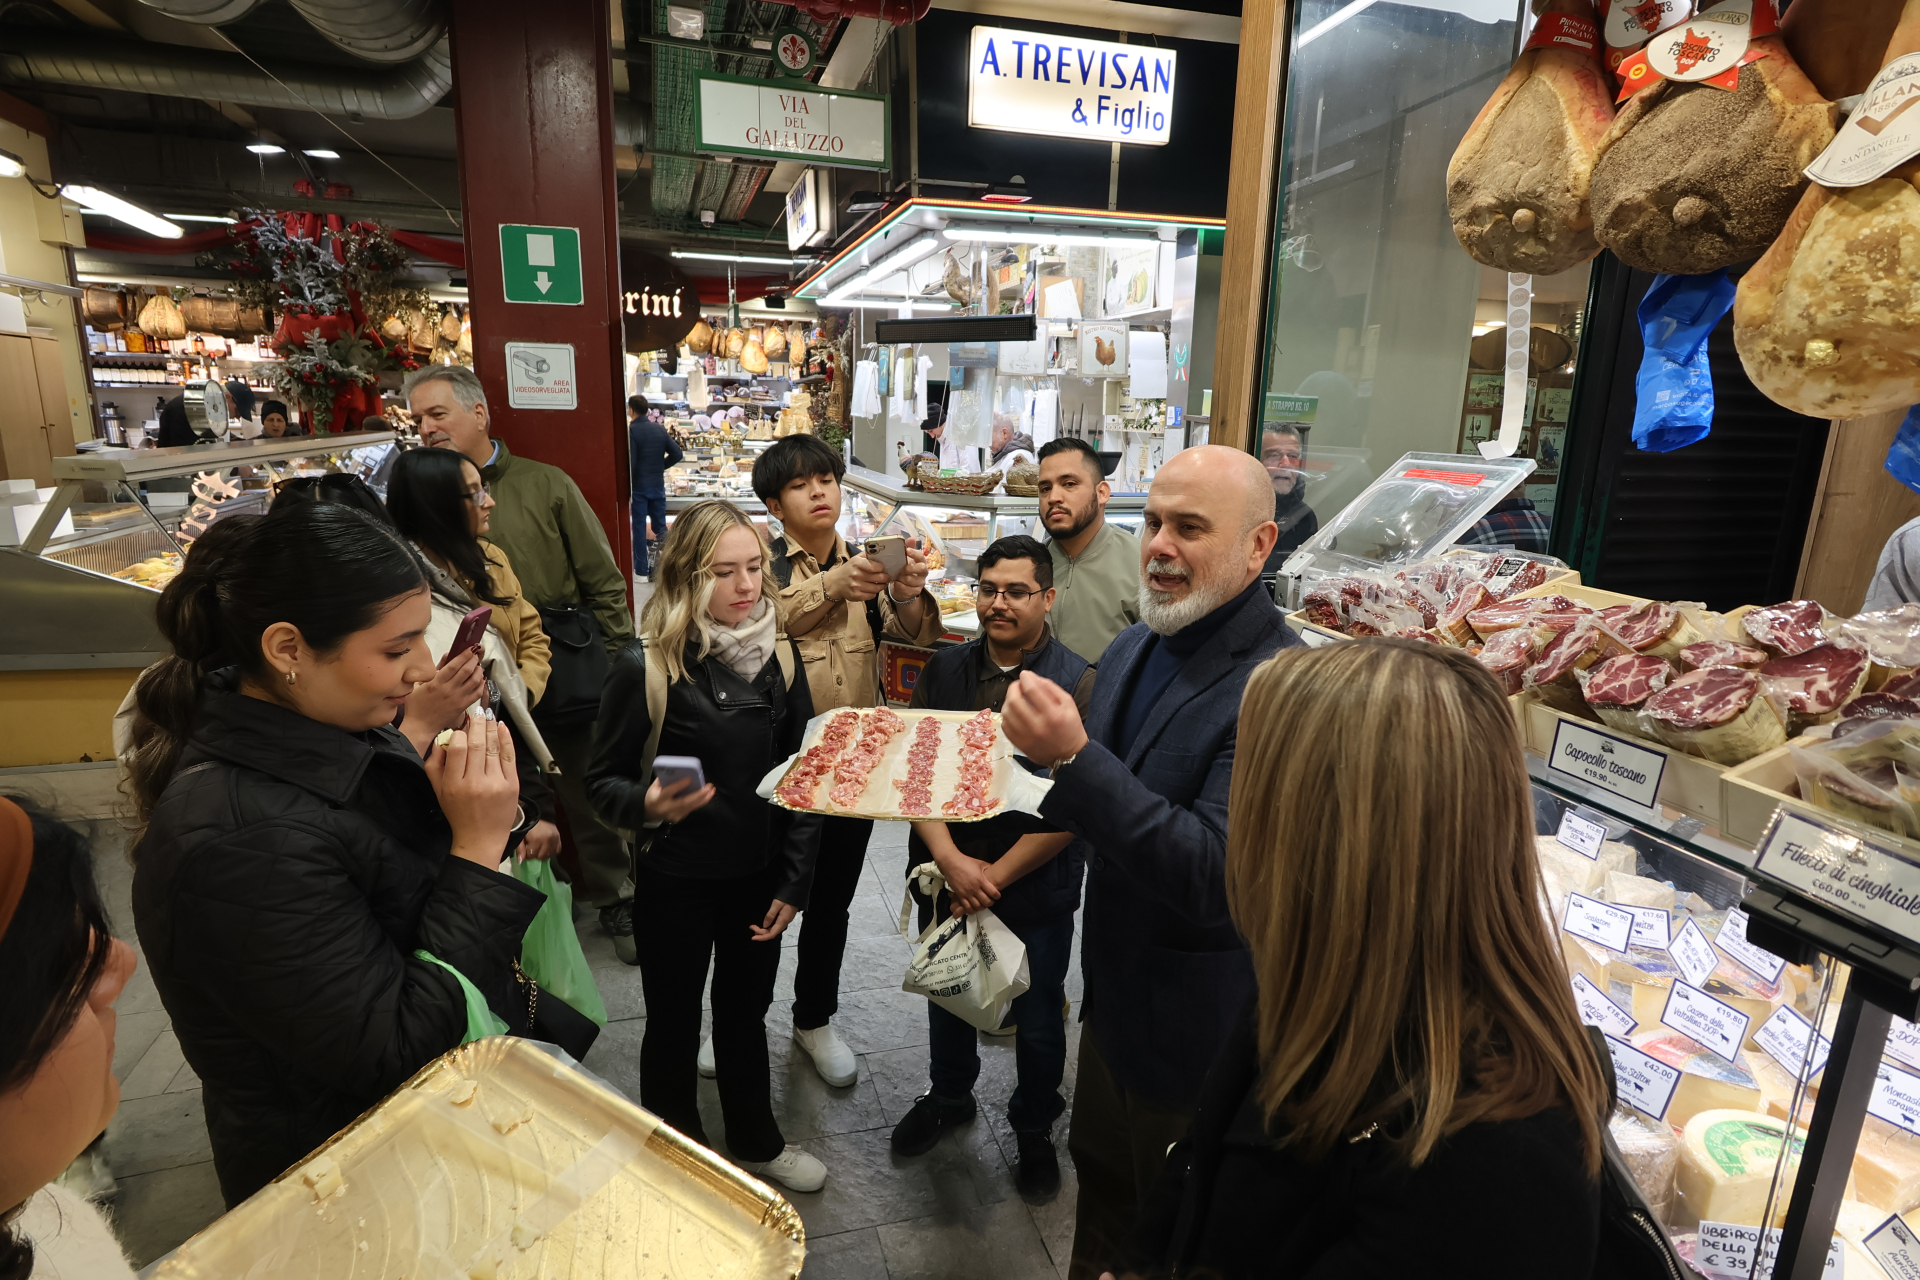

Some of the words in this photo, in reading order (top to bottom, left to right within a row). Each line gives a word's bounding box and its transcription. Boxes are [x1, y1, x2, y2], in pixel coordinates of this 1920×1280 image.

[1644, 16, 1658, 27] DOP
[1667, 47, 1716, 63] TOSCANO
[1671, 41, 1721, 56] PROSCIUTTO
[980, 38, 1171, 94] A.TREVISAN
[1680, 57, 1695, 65] DOP
[778, 95, 809, 114] VIA
[1874, 100, 1898, 114] 1886
[784, 117, 806, 129] DEL
[1072, 98, 1088, 126] &
[1097, 95, 1165, 135] Figlio
[745, 127, 843, 152] GALLUZZO
[1840, 151, 1861, 166] SAN
[1863, 134, 1911, 156] DANIELE
[514, 386, 571, 394] VIDEOSORVEGLIATA
[1565, 743, 1607, 769] Capocollo
[1609, 760, 1647, 785] toscano
[1584, 768, 1608, 783] €19.90
[1812, 878, 1850, 901] €60.00
[1829, 863, 1848, 883] di
[1848, 873, 1920, 916] cinghiale
[1605, 909, 1629, 922] €29.90
[1643, 911, 1665, 920] €17.60
[1582, 1000, 1608, 1022] Ortisei
[1607, 1006, 1630, 1026] €18.80
[1674, 1007, 1702, 1029] Valtellina
[1702, 1022, 1719, 1036] DOP
[1687, 1004, 1709, 1022] Casera
[1709, 1017, 1725, 1031] della
[1717, 1006, 1743, 1025] €19.80
[1780, 1027, 1795, 1043] Piave
[1614, 1059, 1628, 1074] Blue
[1628, 1067, 1652, 1086] Stilton
[1644, 1060, 1673, 1080] €42.00
[1883, 1085, 1920, 1106] Montasi
[1702, 1239, 1746, 1254] DELLA
[1703, 1254, 1719, 1266] €
